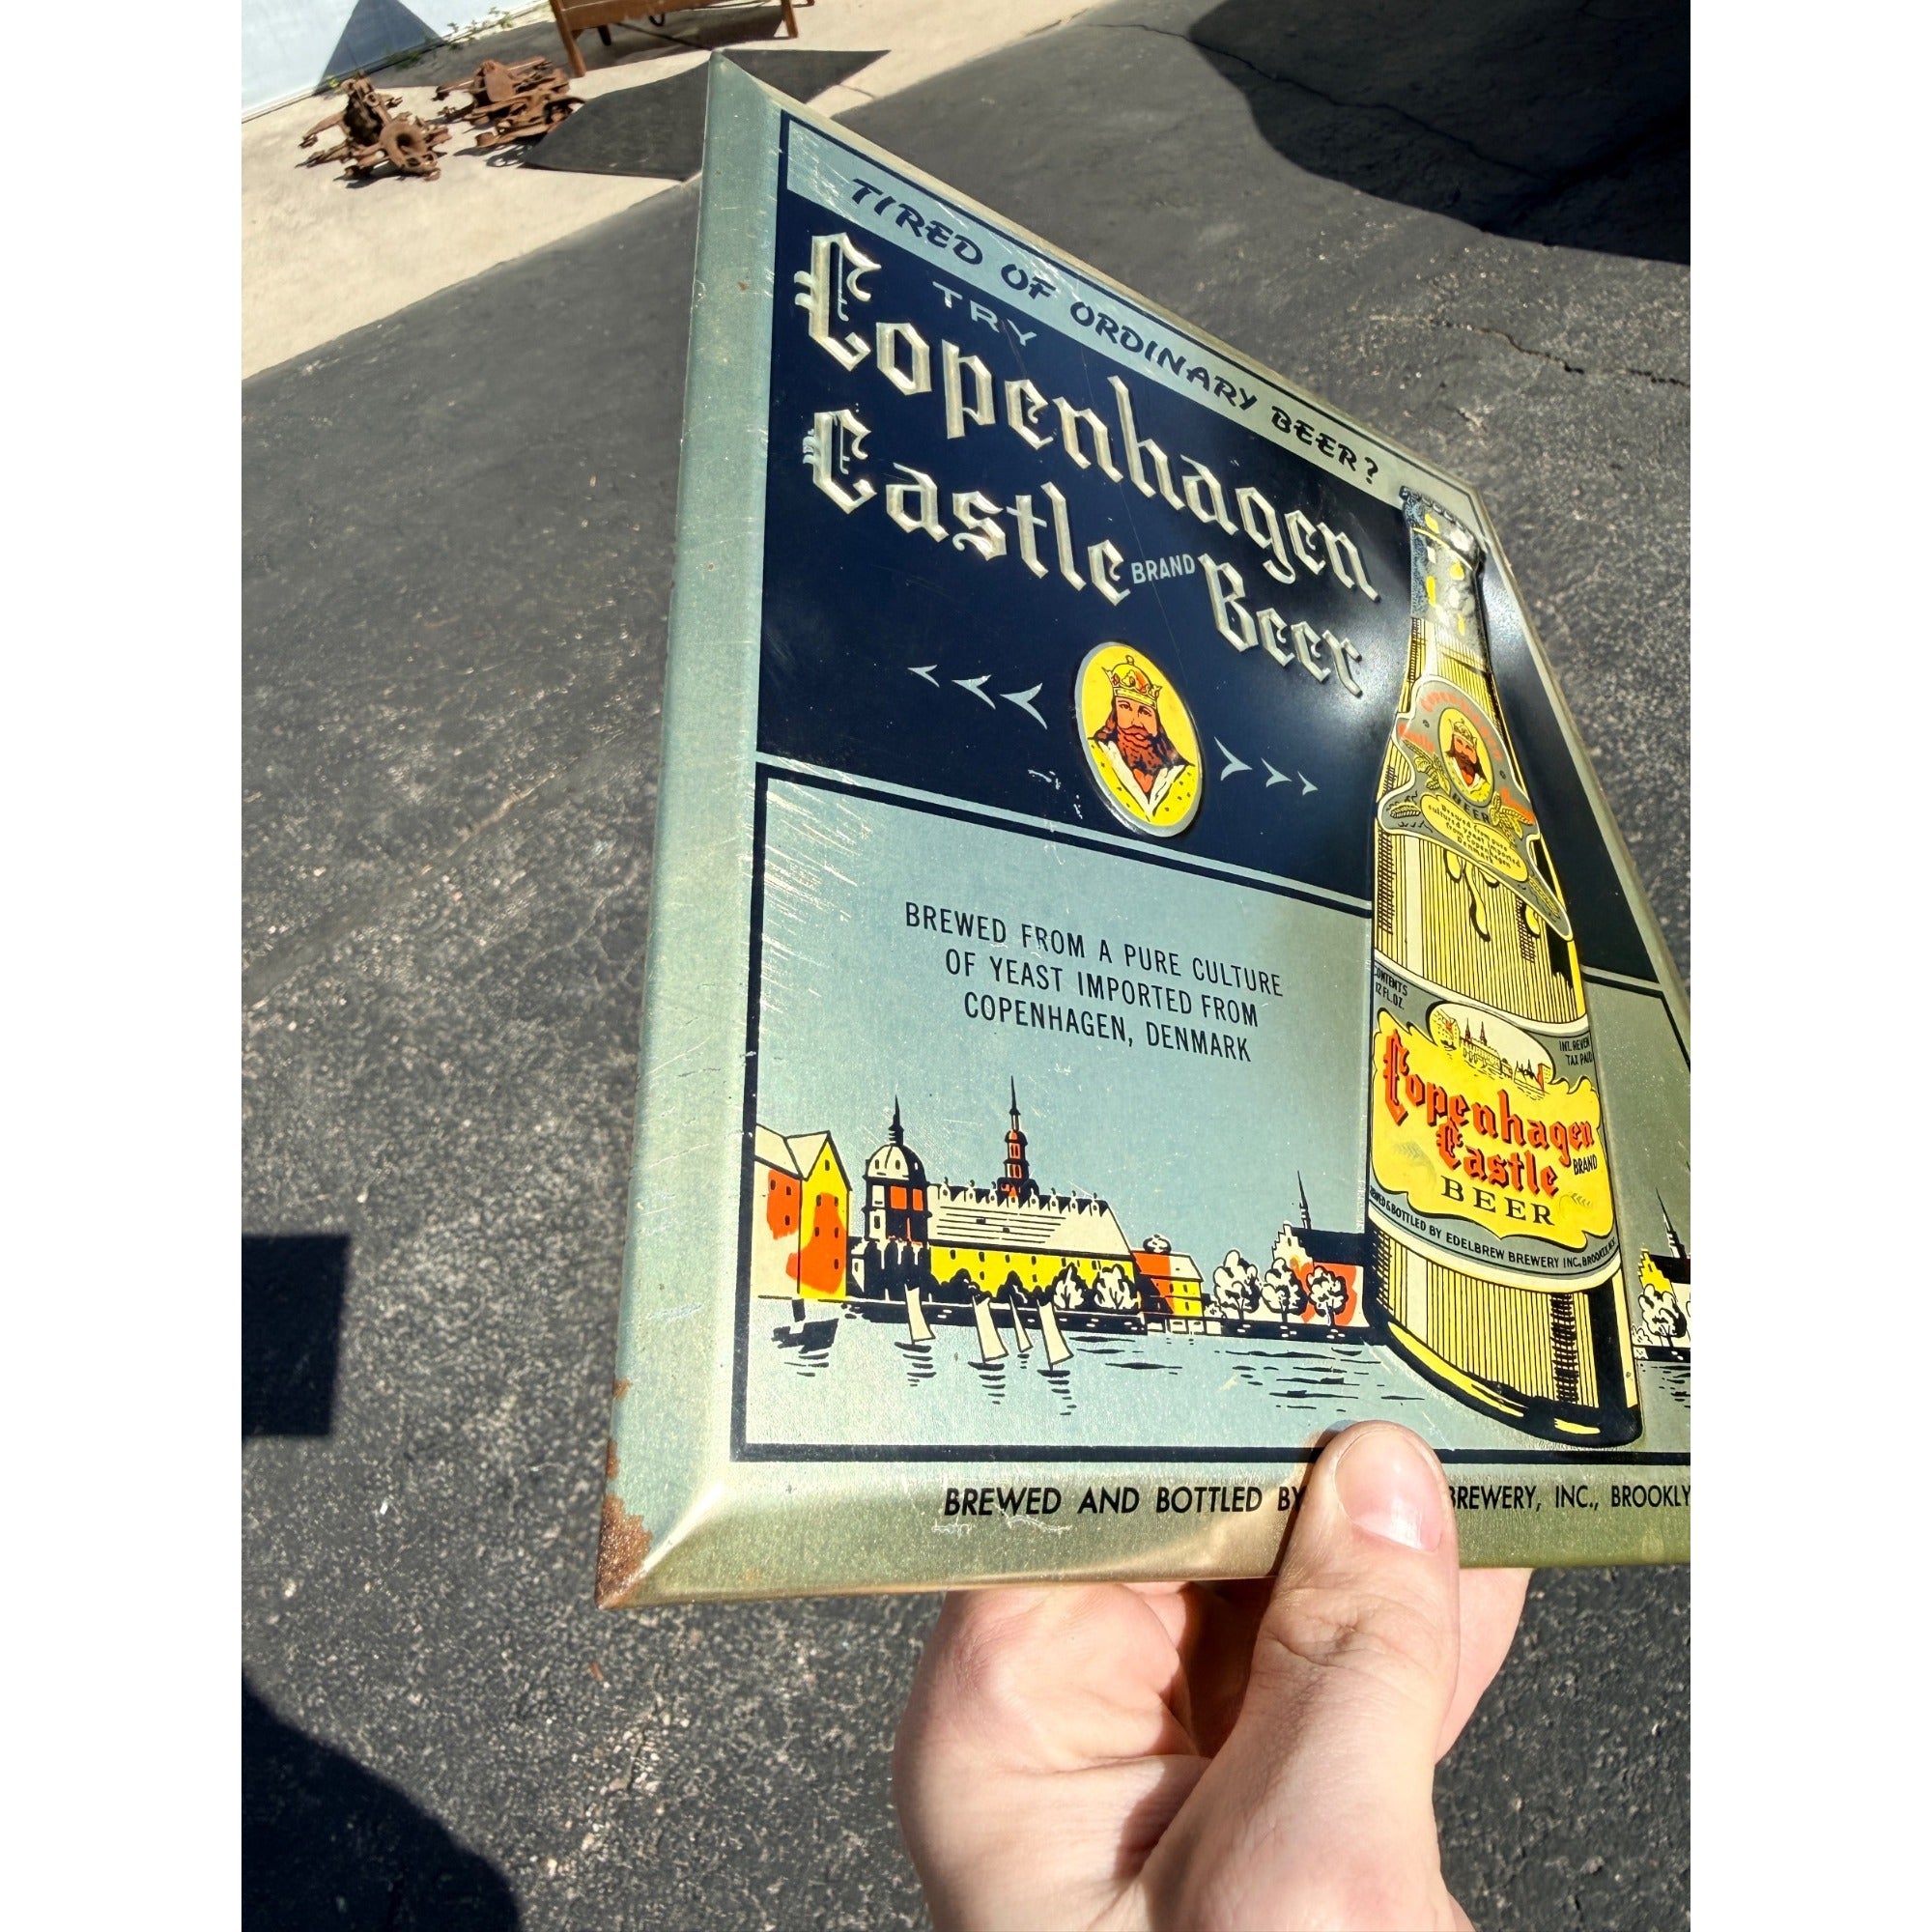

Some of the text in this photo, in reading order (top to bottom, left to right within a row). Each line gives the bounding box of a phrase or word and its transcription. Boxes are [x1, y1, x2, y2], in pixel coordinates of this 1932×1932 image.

[850, 178, 1379, 484] TIRED OF ORDINARY BEER?
[932, 281, 1038, 347] TRY
[793, 232, 1381, 603] Copenhagen
[802, 409, 1363, 698] Castle BRAND Beer
[905, 901, 1284, 998] BREWED FROM A PURE CULTURE
[945, 948, 1259, 1028] OF YEAST IMPORTED FROM
[964, 991, 1252, 1063] COPENHAGEN, DENMARK
[1382, 1029, 1595, 1168] Copenhagen
[1435, 1116, 1599, 1200] Castle BRAND
[1441, 1175, 1556, 1227] BEER
[1429, 1224, 1442, 1239] BY
[1446, 1232, 1505, 1261] EDELBREW
[1508, 1251, 1560, 1268] BREWERY
[944, 1487, 1062, 1517] BREWED
[1077, 1486, 1141, 1515] AND
[1155, 1486, 1263, 1514] BOTTLED
[1277, 1486, 1307, 1512] BY
[1555, 1484, 1599, 1512] INC.,
